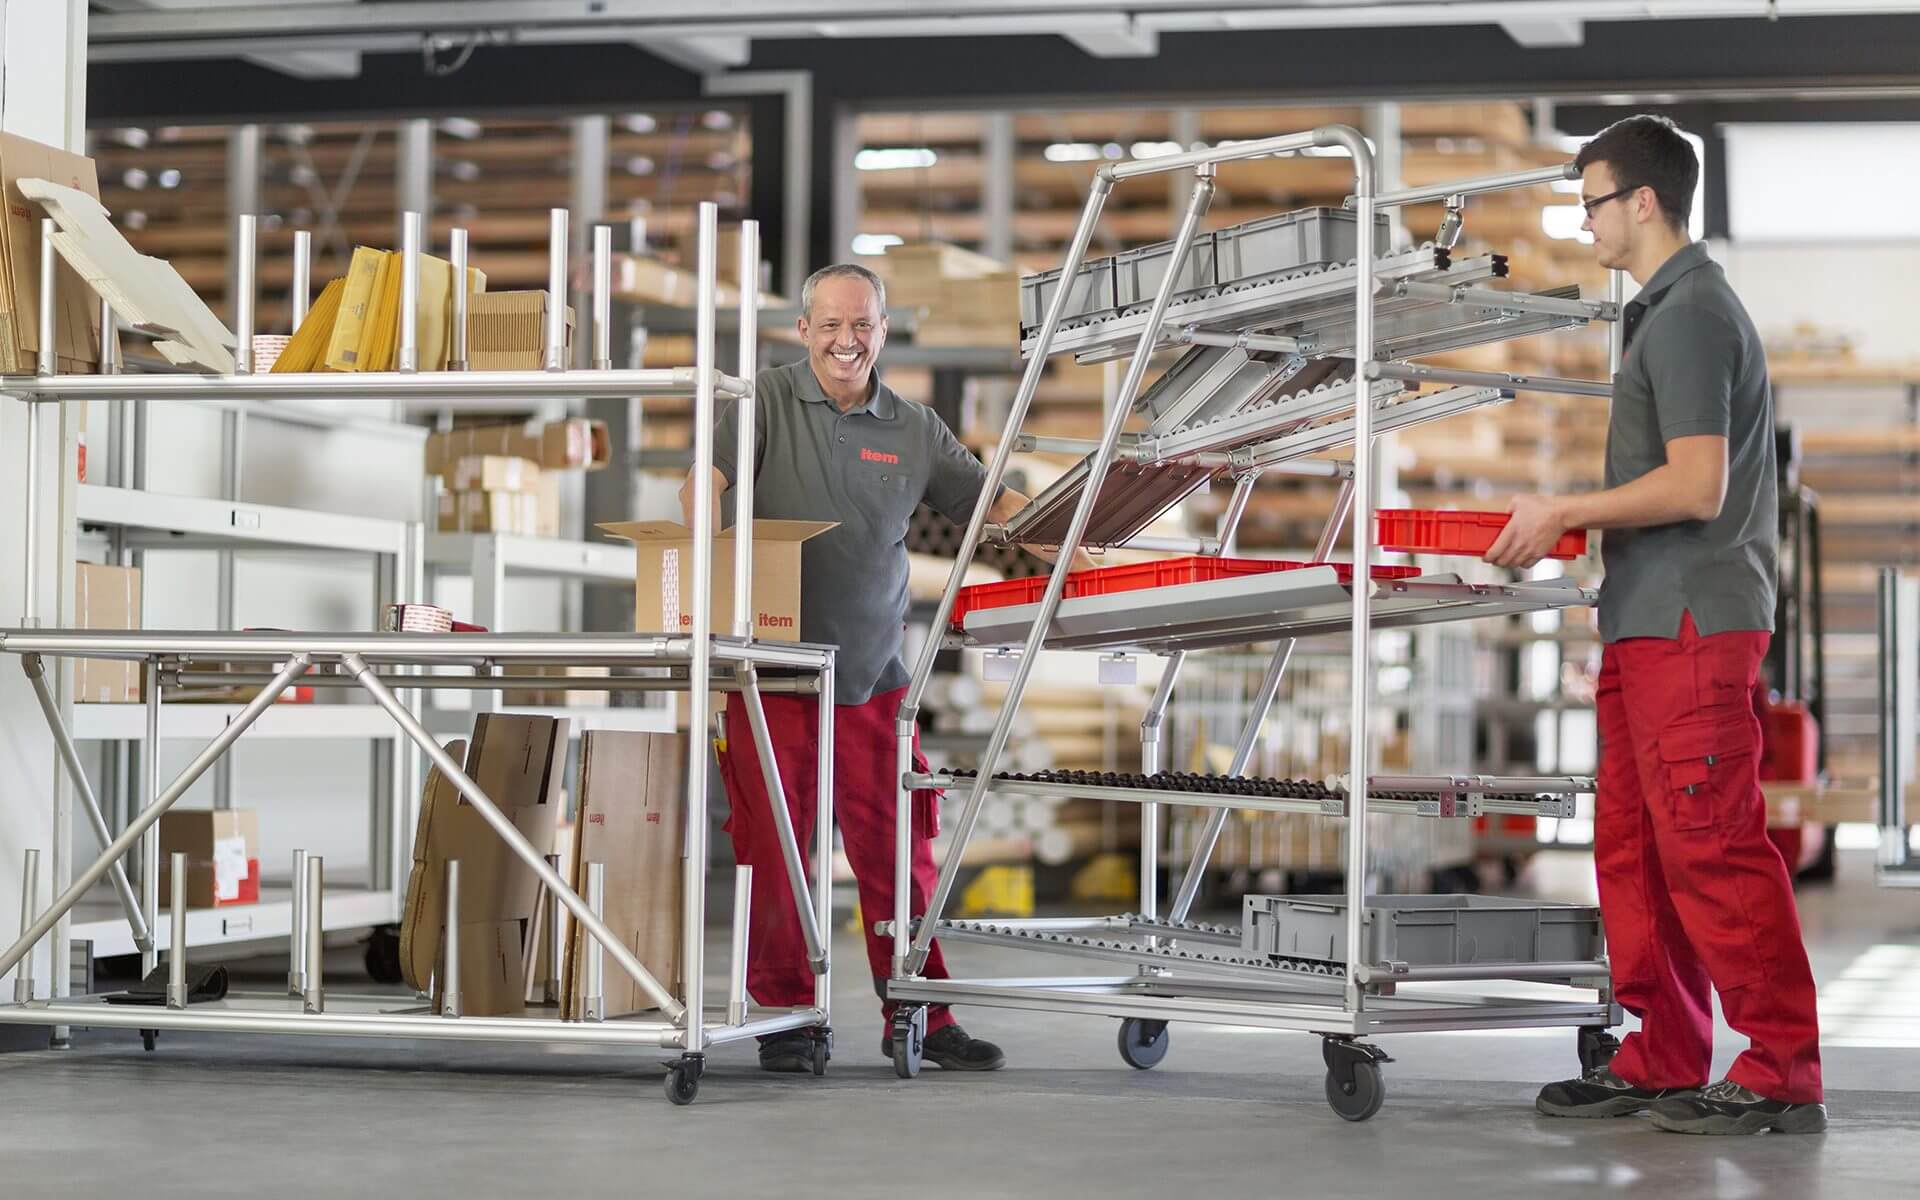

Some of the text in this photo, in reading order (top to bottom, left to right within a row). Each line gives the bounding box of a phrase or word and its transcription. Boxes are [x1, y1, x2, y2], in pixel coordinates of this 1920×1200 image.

[861, 447, 898, 464] item
[678, 612, 693, 626] te
[759, 612, 793, 627] item
